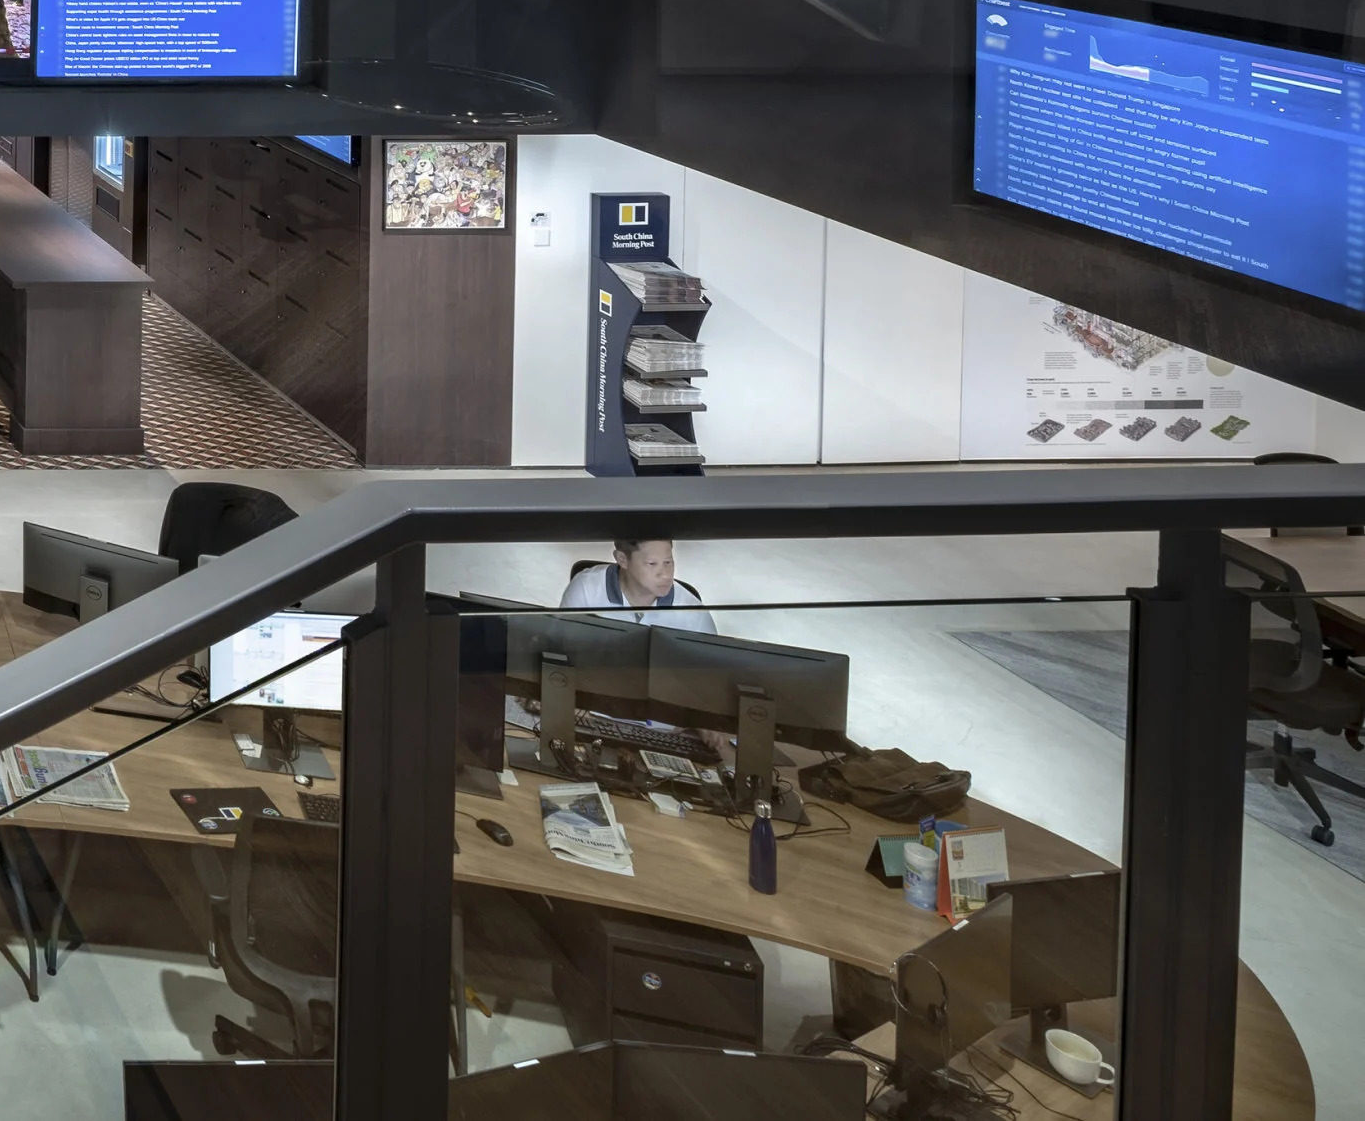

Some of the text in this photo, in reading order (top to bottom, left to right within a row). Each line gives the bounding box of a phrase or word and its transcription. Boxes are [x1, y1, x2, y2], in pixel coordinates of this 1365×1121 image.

[633, 232, 653, 240] China
[612, 241, 640, 249] Morning
[597, 318, 608, 432] South China Morning Post
